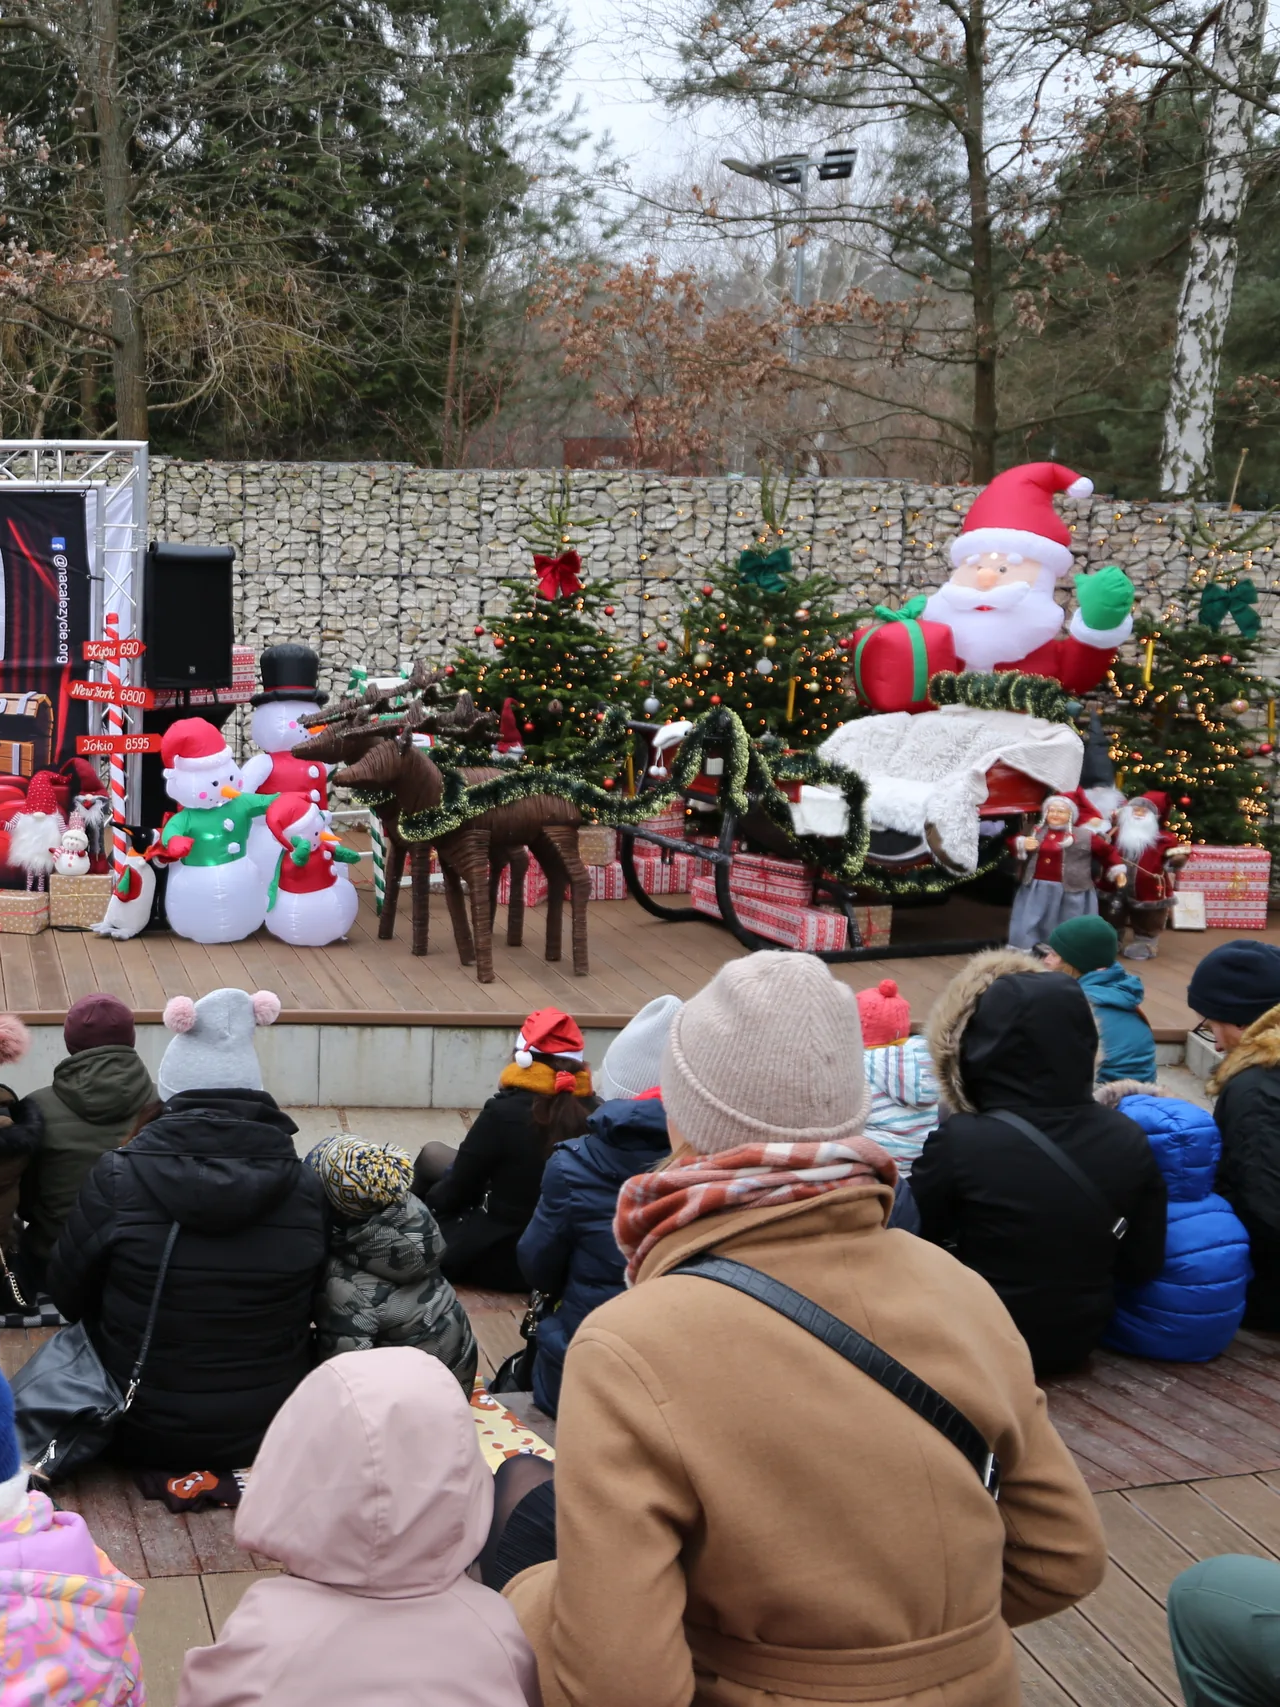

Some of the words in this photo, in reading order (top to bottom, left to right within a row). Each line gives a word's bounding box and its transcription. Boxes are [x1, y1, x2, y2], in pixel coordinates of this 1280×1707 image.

[53, 554, 70, 664] @nacalezycie.org
[120, 641, 139, 656] 690
[71, 683, 95, 697] New
[94, 685, 116, 700] York
[120, 689, 146, 704] 6800
[81, 738, 114, 752] Tokio
[125, 737, 150, 750] 8595
